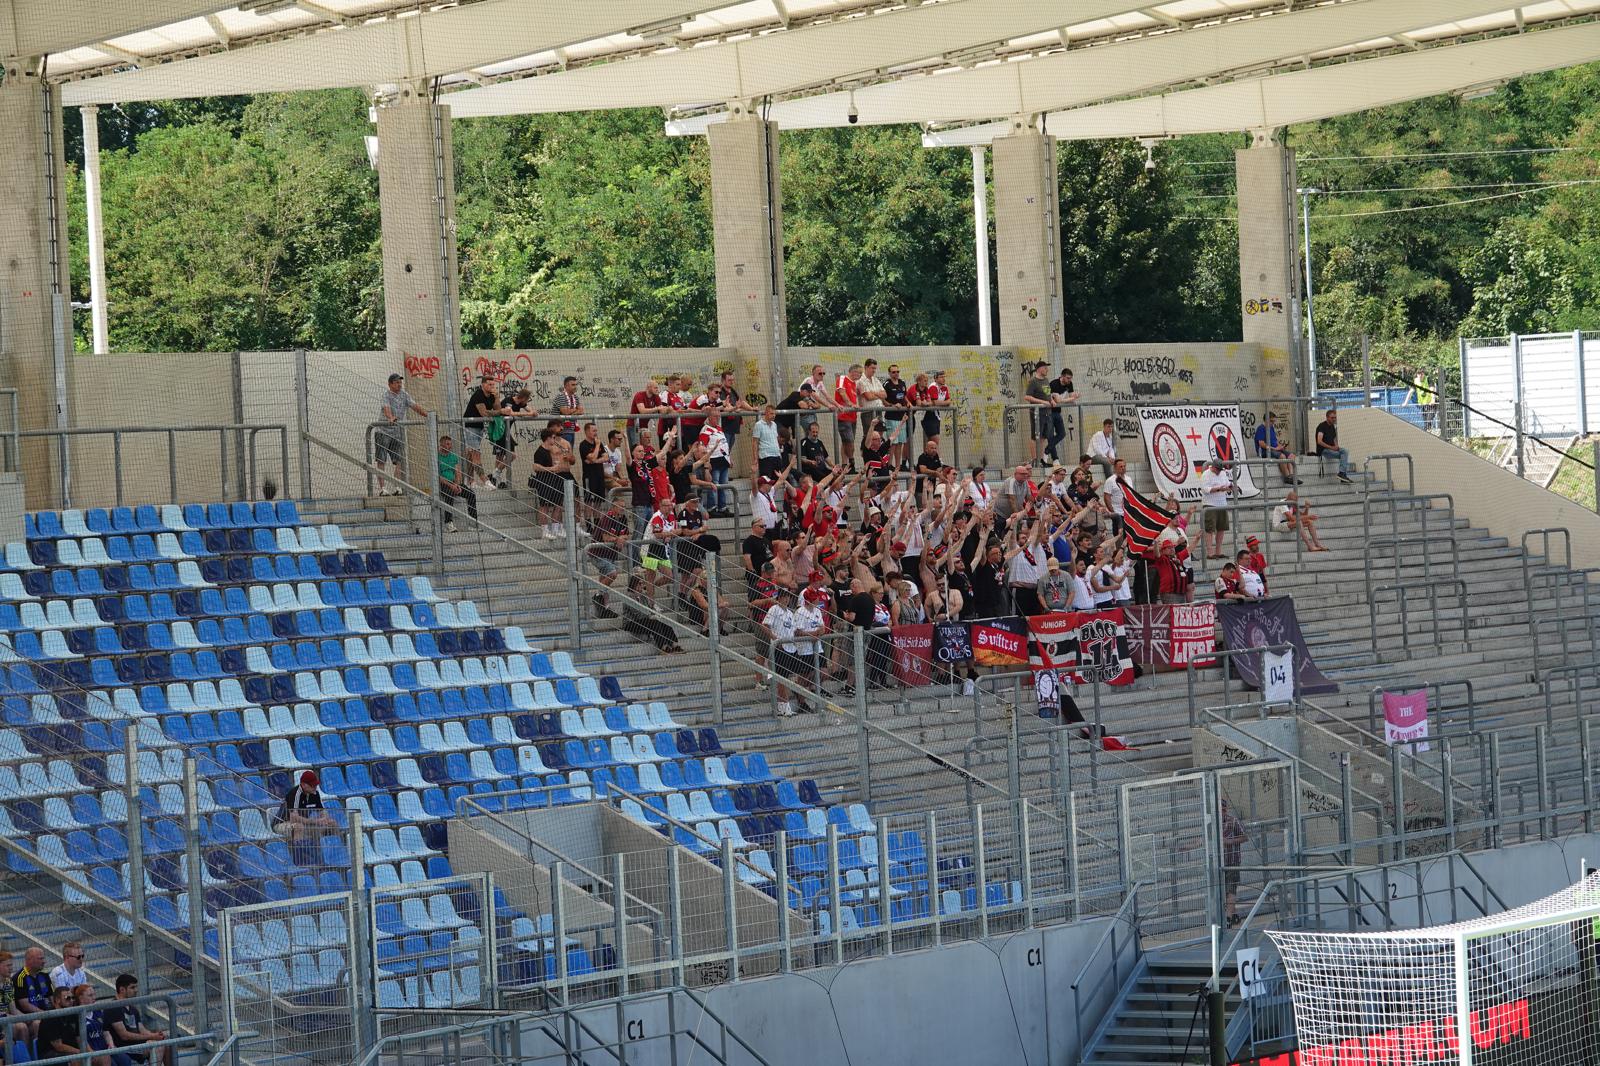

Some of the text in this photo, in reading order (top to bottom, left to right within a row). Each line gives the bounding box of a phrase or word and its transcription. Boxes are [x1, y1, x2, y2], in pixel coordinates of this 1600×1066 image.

[1141, 407, 1237, 420] CARSHALTON ATHLETIC
[1040, 620, 1067, 629] JUNIORS
[1173, 604, 1215, 628] VEREINS
[1080, 619, 1117, 641] BLOCK
[1173, 640, 1217, 664] LIEBE
[1400, 706, 1414, 717] THE
[1028, 947, 1042, 966] C1
[1241, 959, 1258, 986] C1
[627, 1019, 645, 1040] C1
